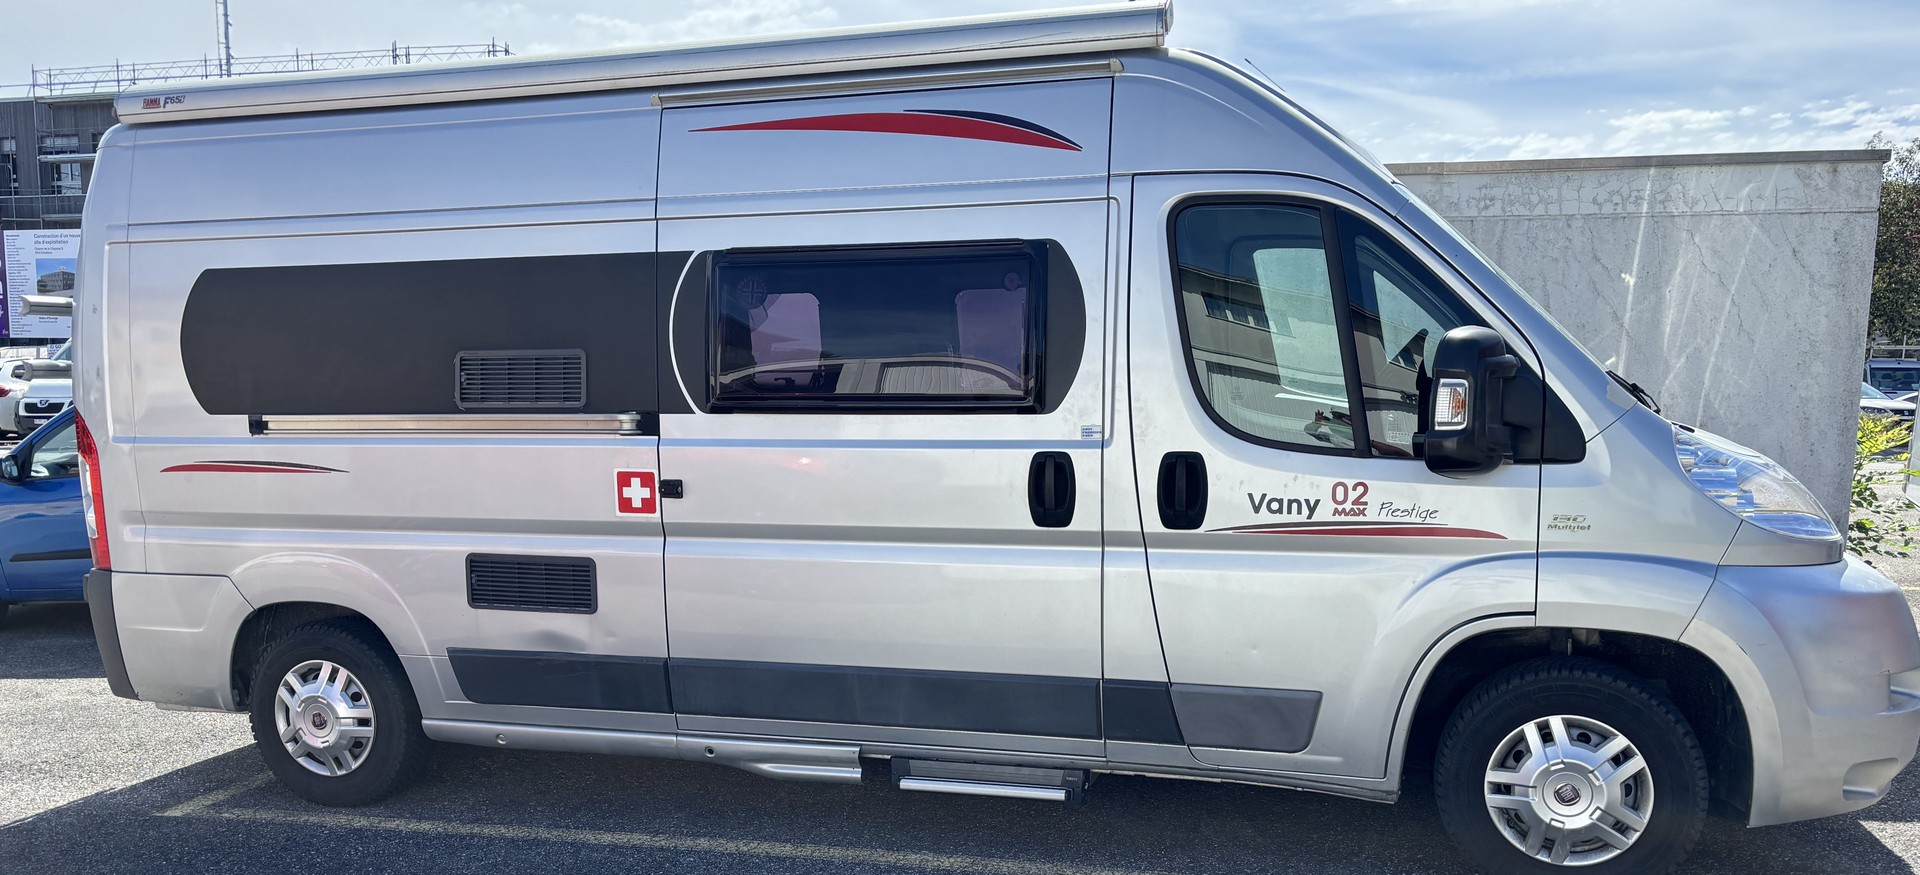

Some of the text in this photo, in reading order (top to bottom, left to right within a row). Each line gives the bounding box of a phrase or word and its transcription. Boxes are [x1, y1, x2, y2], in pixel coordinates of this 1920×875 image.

[1247, 481, 1439, 522] Vany 02 MAX Prestige
[1547, 524, 1592, 532] Multijet
[1559, 786, 1575, 801] FIAT
